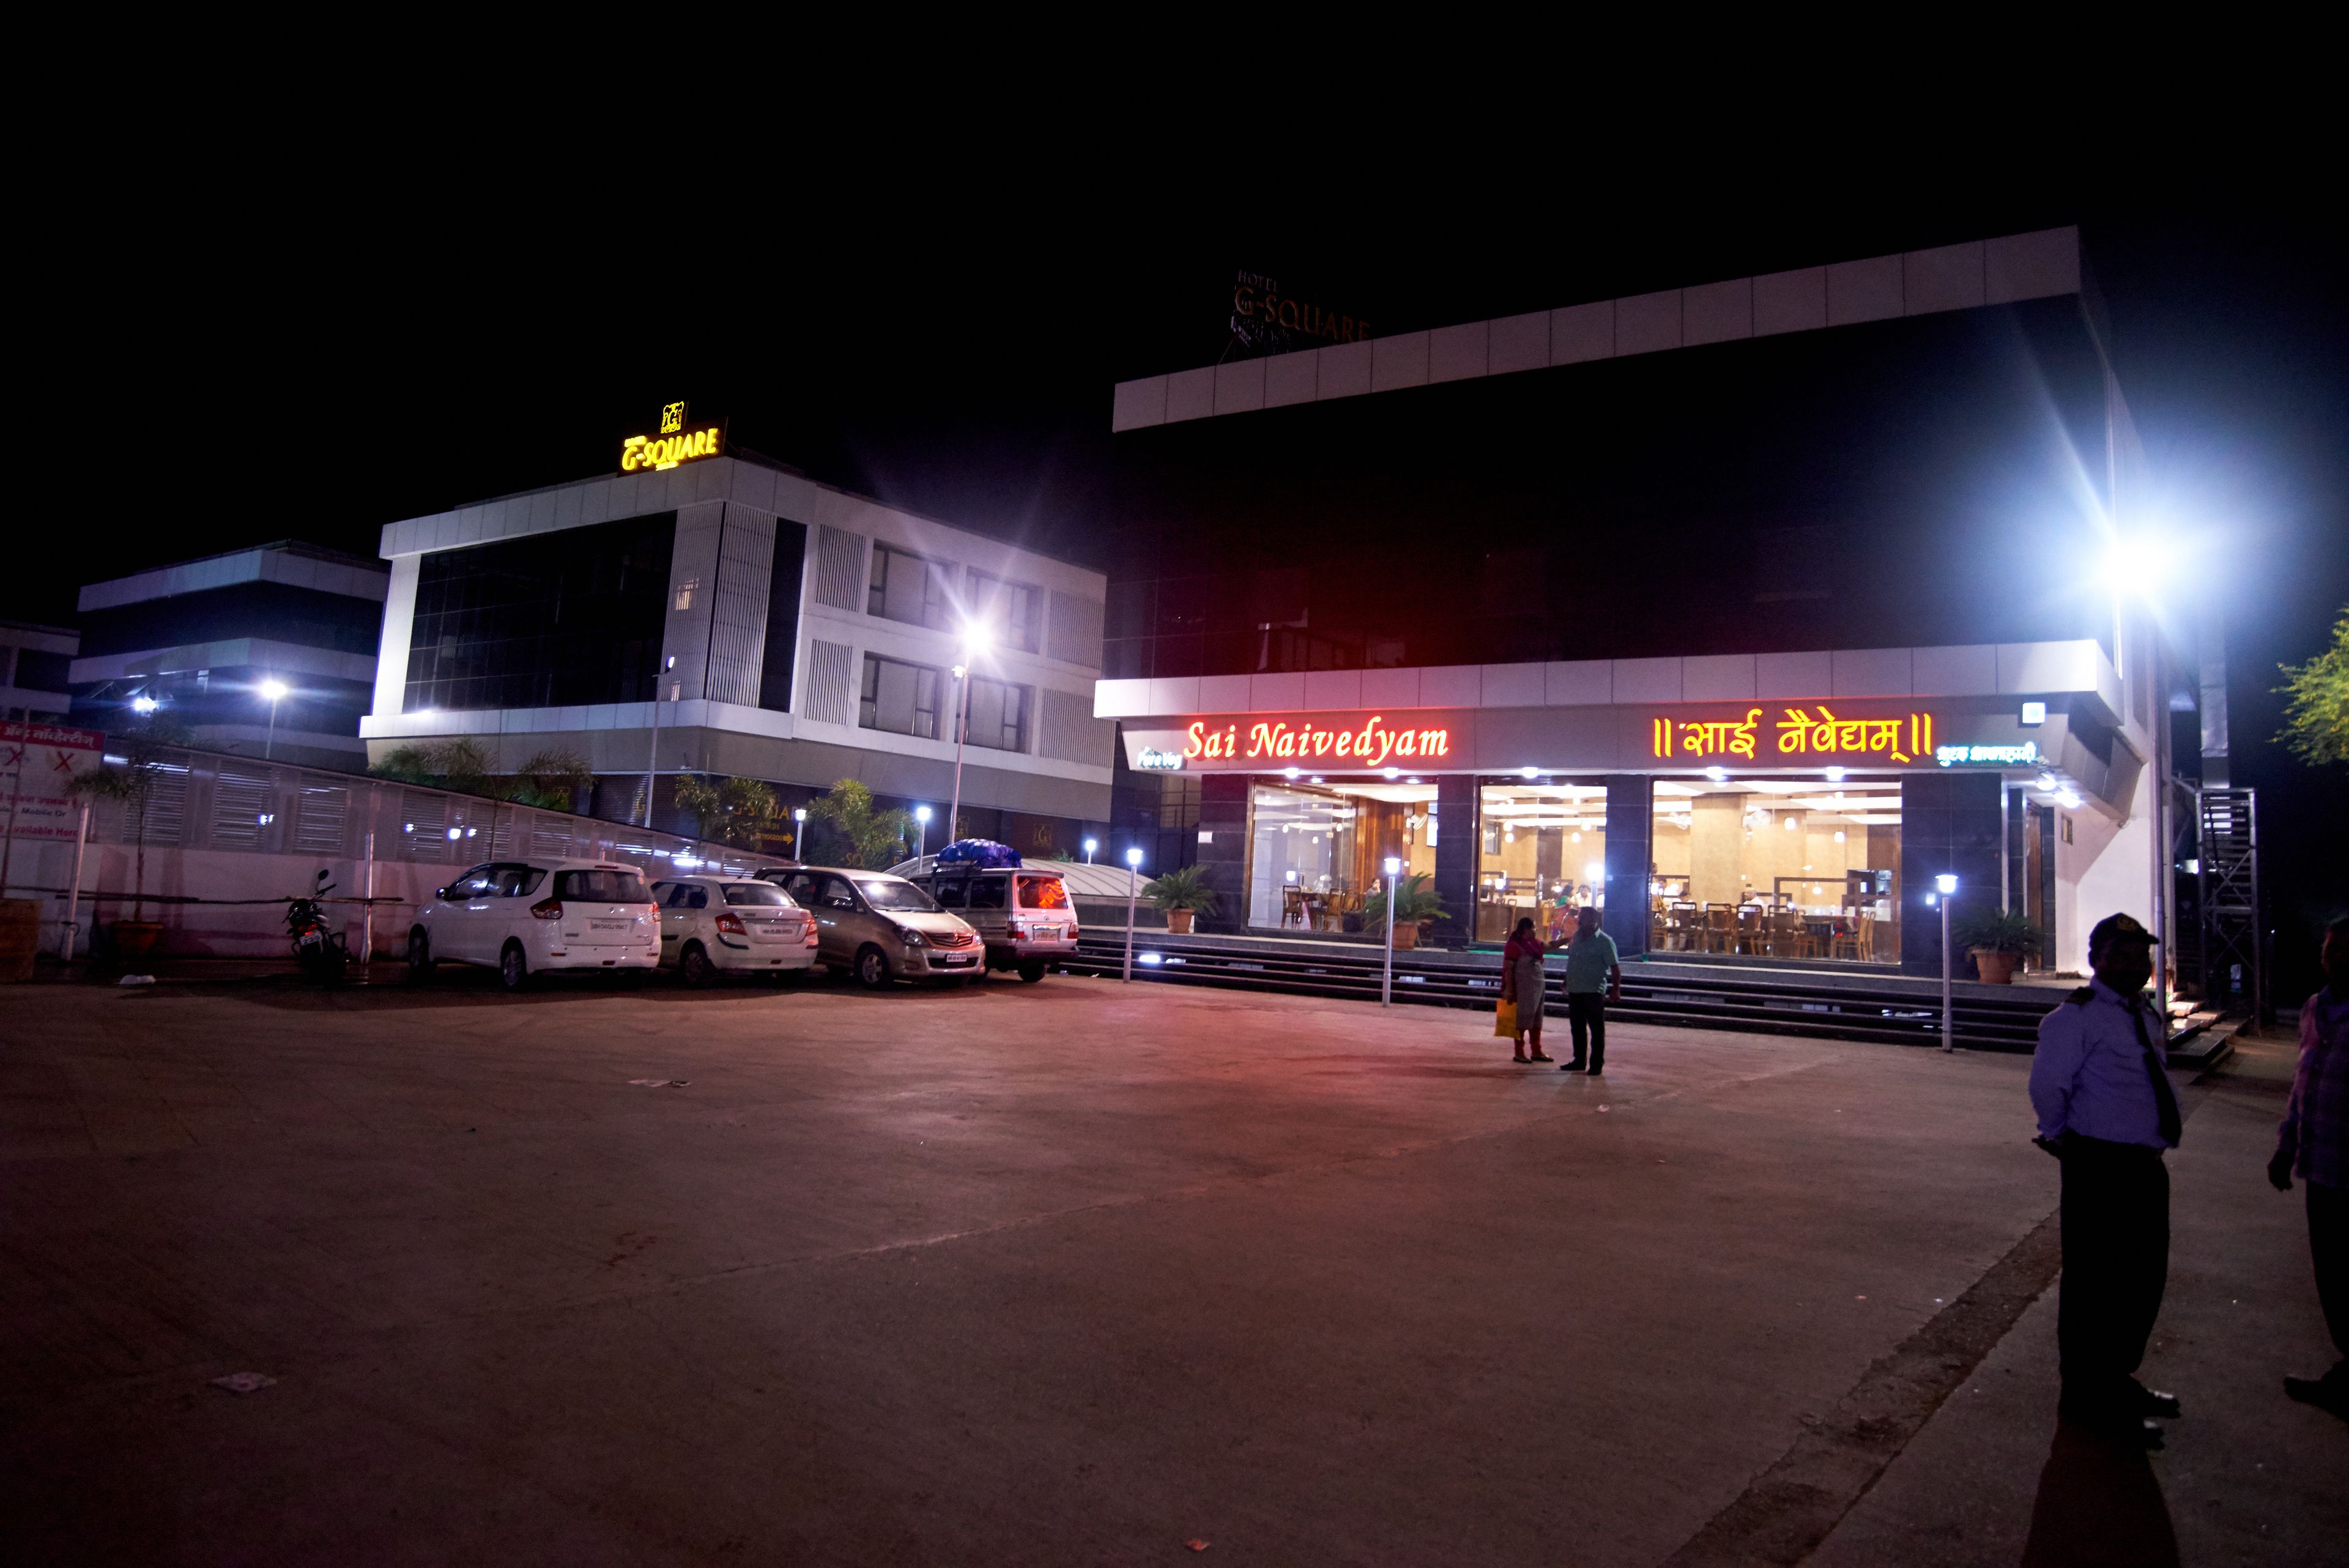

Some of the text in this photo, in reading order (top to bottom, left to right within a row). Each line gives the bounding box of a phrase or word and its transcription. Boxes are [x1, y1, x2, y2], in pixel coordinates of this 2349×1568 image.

[1238, 269, 1278, 292] HOTEL
[1234, 285, 1371, 343] G-SQUARE
[622, 428, 719, 471] G-SQUARE
[1183, 715, 1449, 767] Sai Naivedyam
[1776, 705, 1910, 764] नैवेद्यम्
[14, 826, 53, 835] vailable
[21, 808, 52, 816] Mobile
